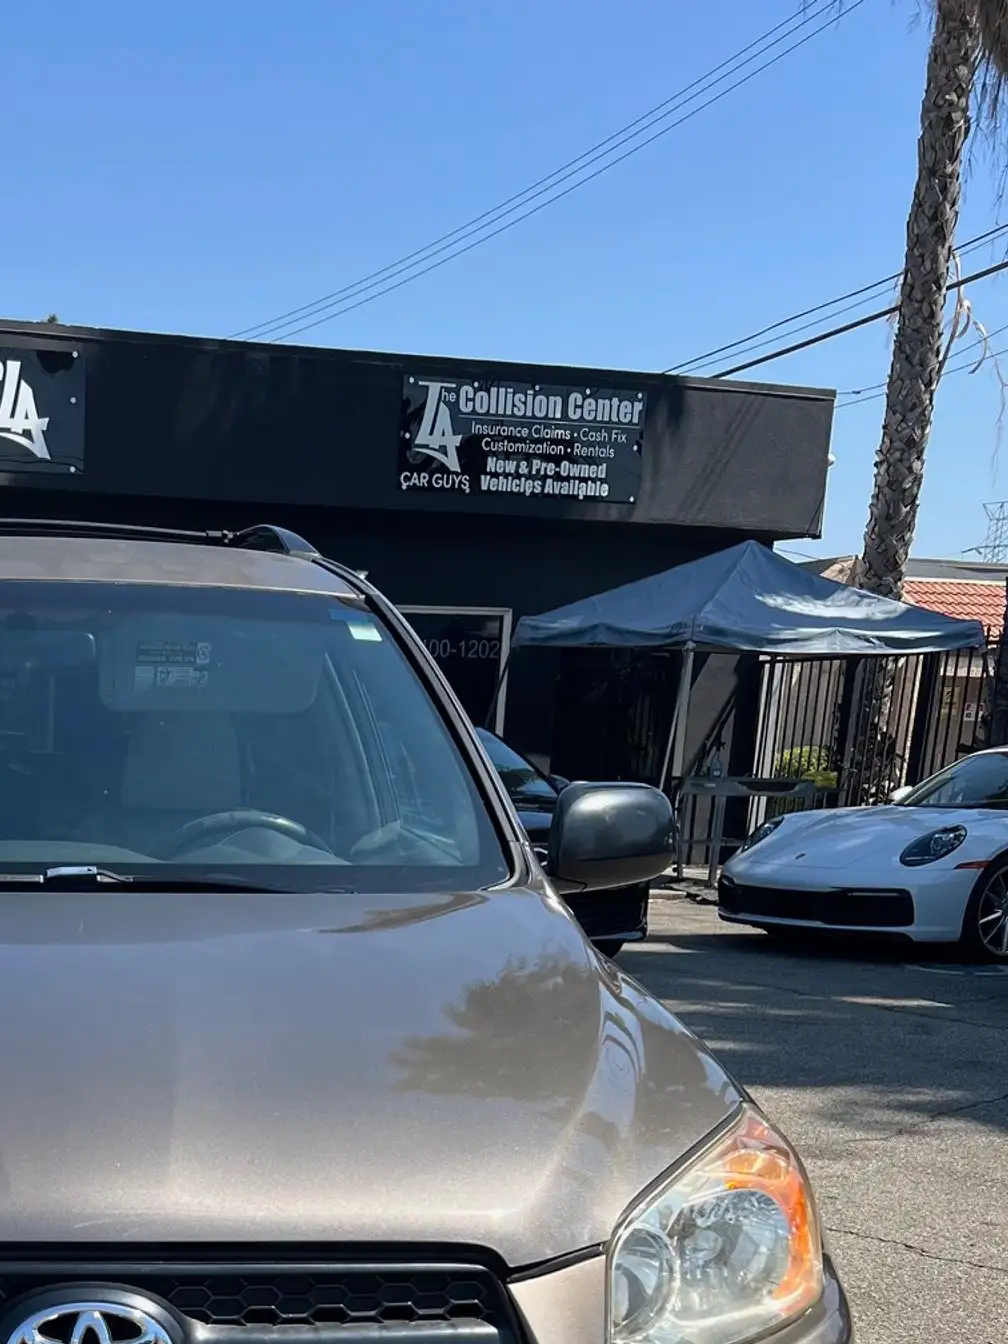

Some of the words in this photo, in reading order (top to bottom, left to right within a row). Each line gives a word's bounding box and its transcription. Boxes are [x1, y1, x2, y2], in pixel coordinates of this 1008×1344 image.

[458, 385, 563, 419] Collision
[567, 392, 643, 424] Center
[471, 420, 529, 437] Insurance
[531, 424, 571, 440] Claims
[579, 427, 608, 443] Cash
[611, 430, 627, 443] Fix
[481, 437, 564, 455] Customization
[573, 443, 615, 458] Rentals
[486, 456, 517, 473] New
[518, 460, 529, 473] &
[531, 458, 607, 479] Pre-Owned
[400, 471, 428, 488] CAR
[431, 473, 470, 490] GUYS
[480, 474, 542, 494] Vehicles
[544, 478, 609, 497] Available
[424, 638, 500, 658] 00-1202
